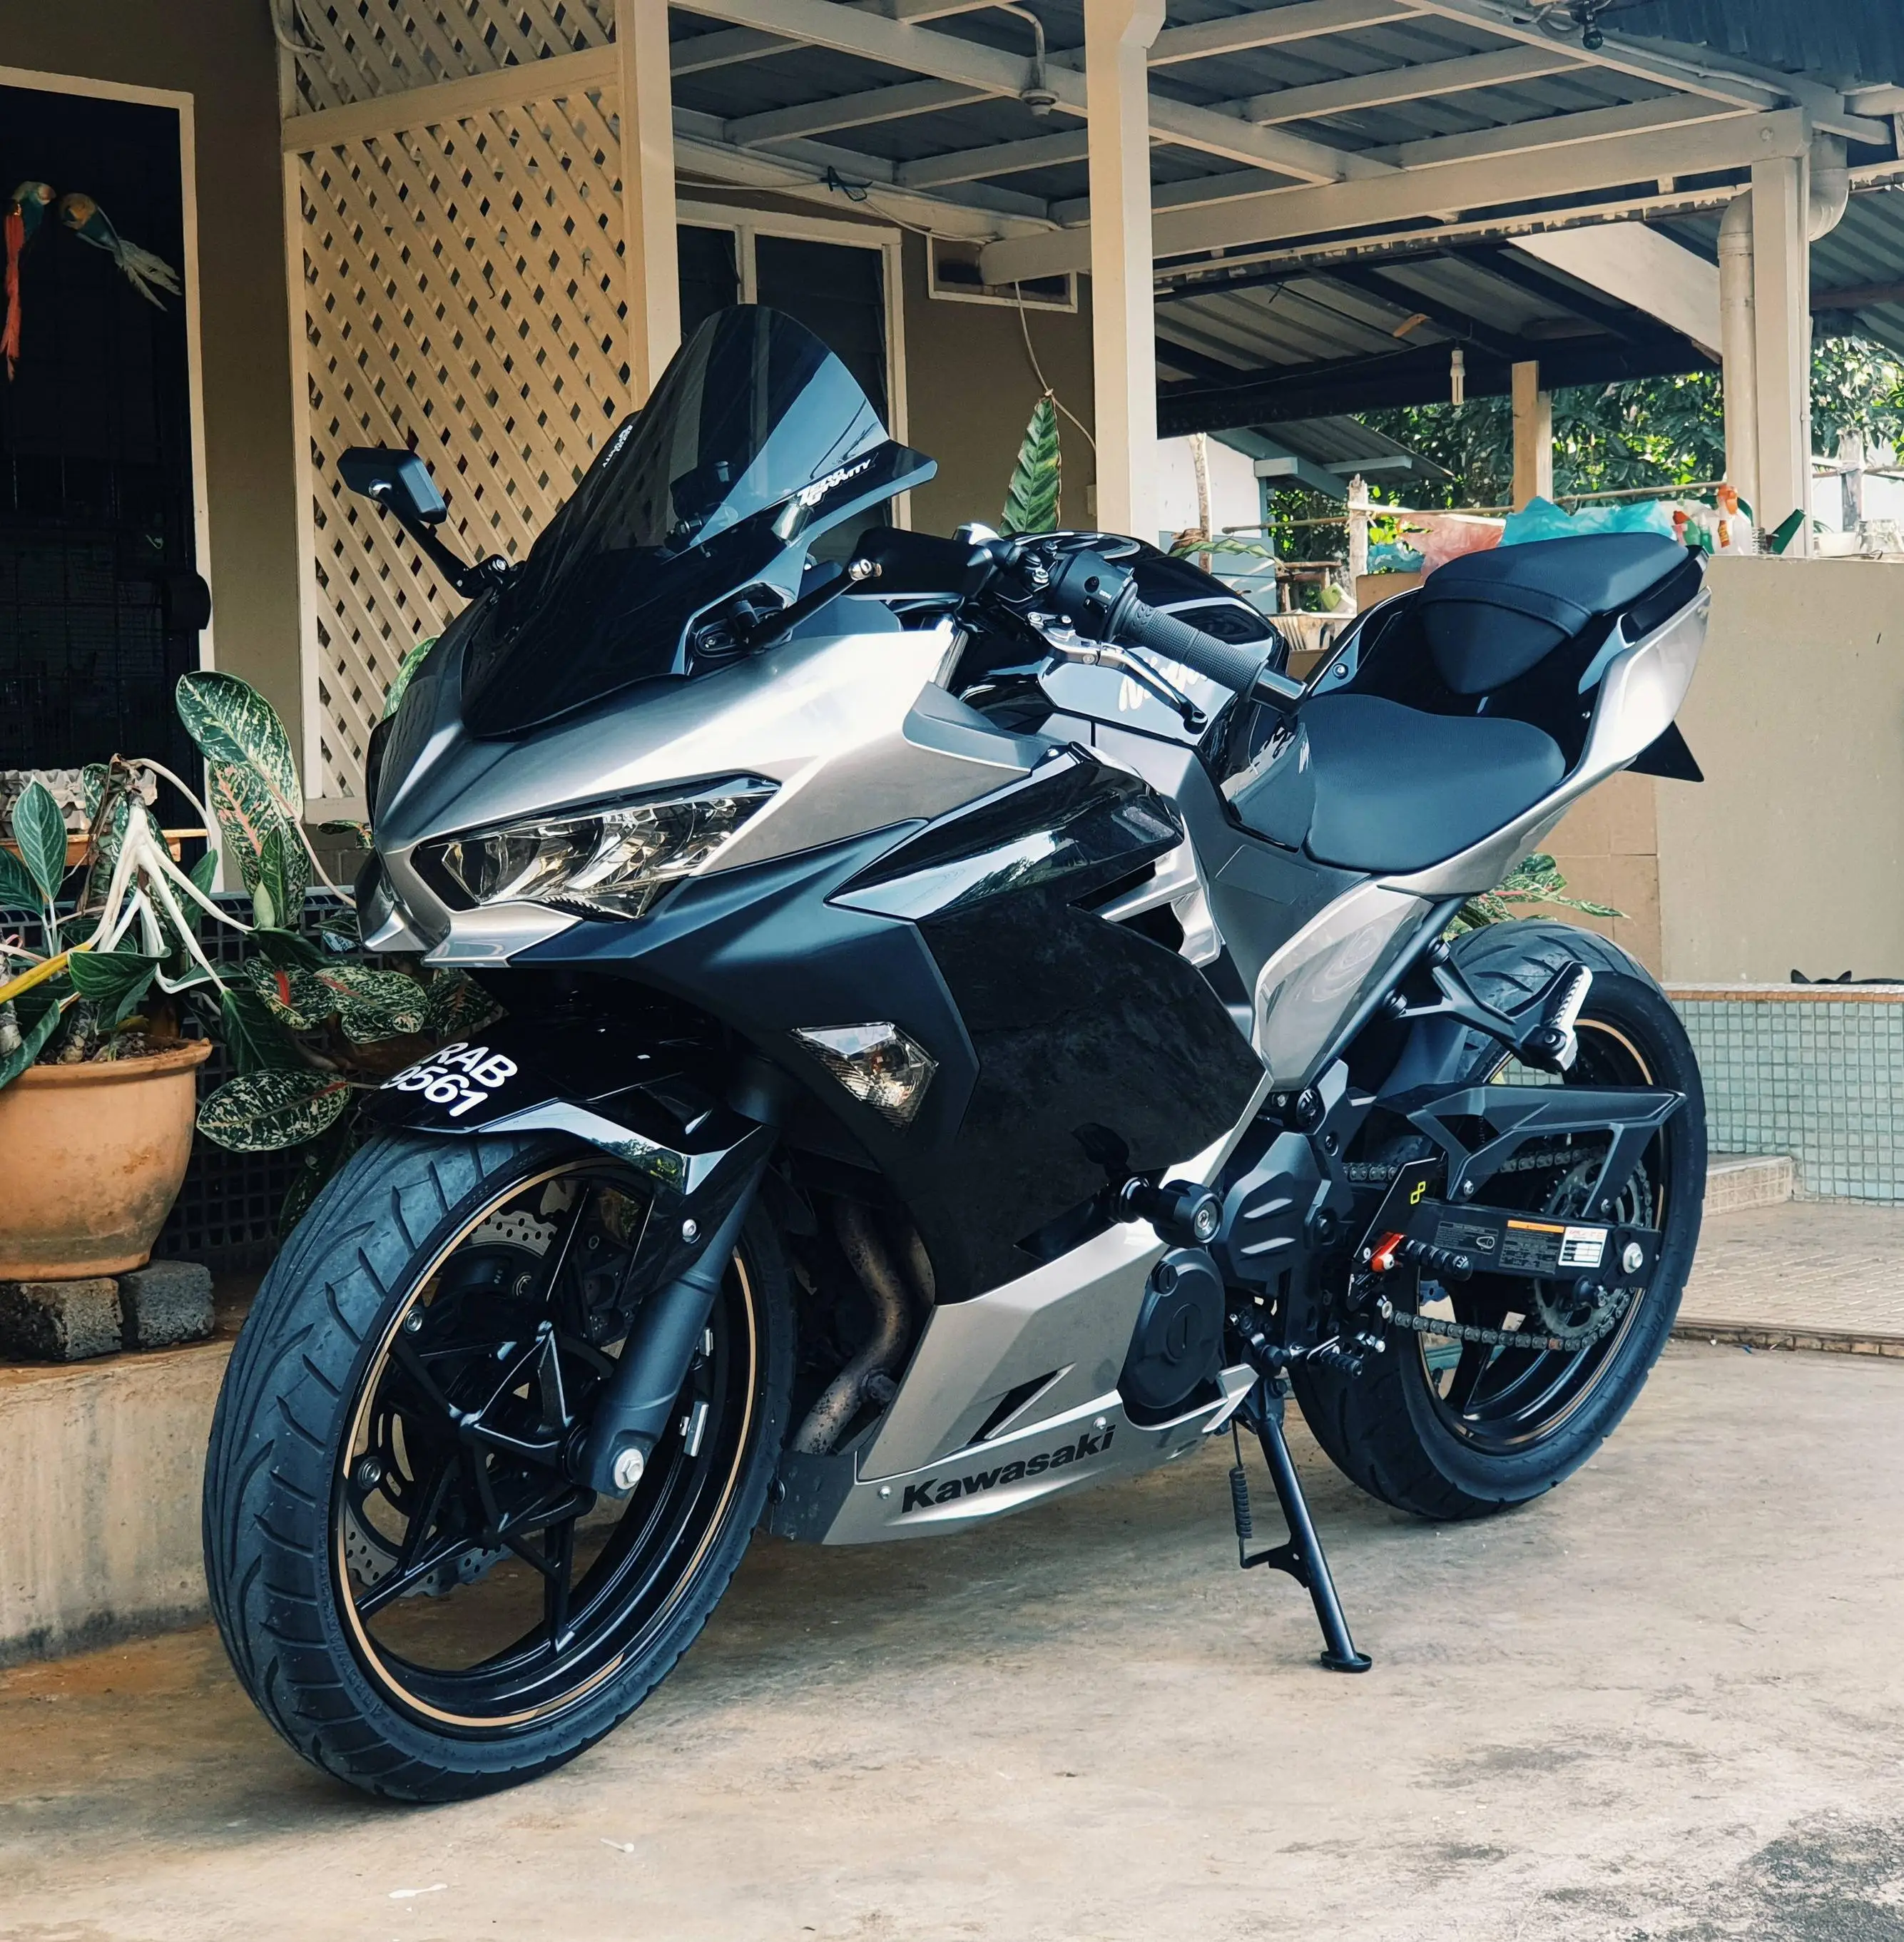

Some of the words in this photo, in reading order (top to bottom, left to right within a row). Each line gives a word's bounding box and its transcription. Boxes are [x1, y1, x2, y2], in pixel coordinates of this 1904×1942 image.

[421, 1042, 518, 1087] RAB
[380, 1065, 489, 1117] 9561
[901, 1424, 1117, 1513] Kawasaki
